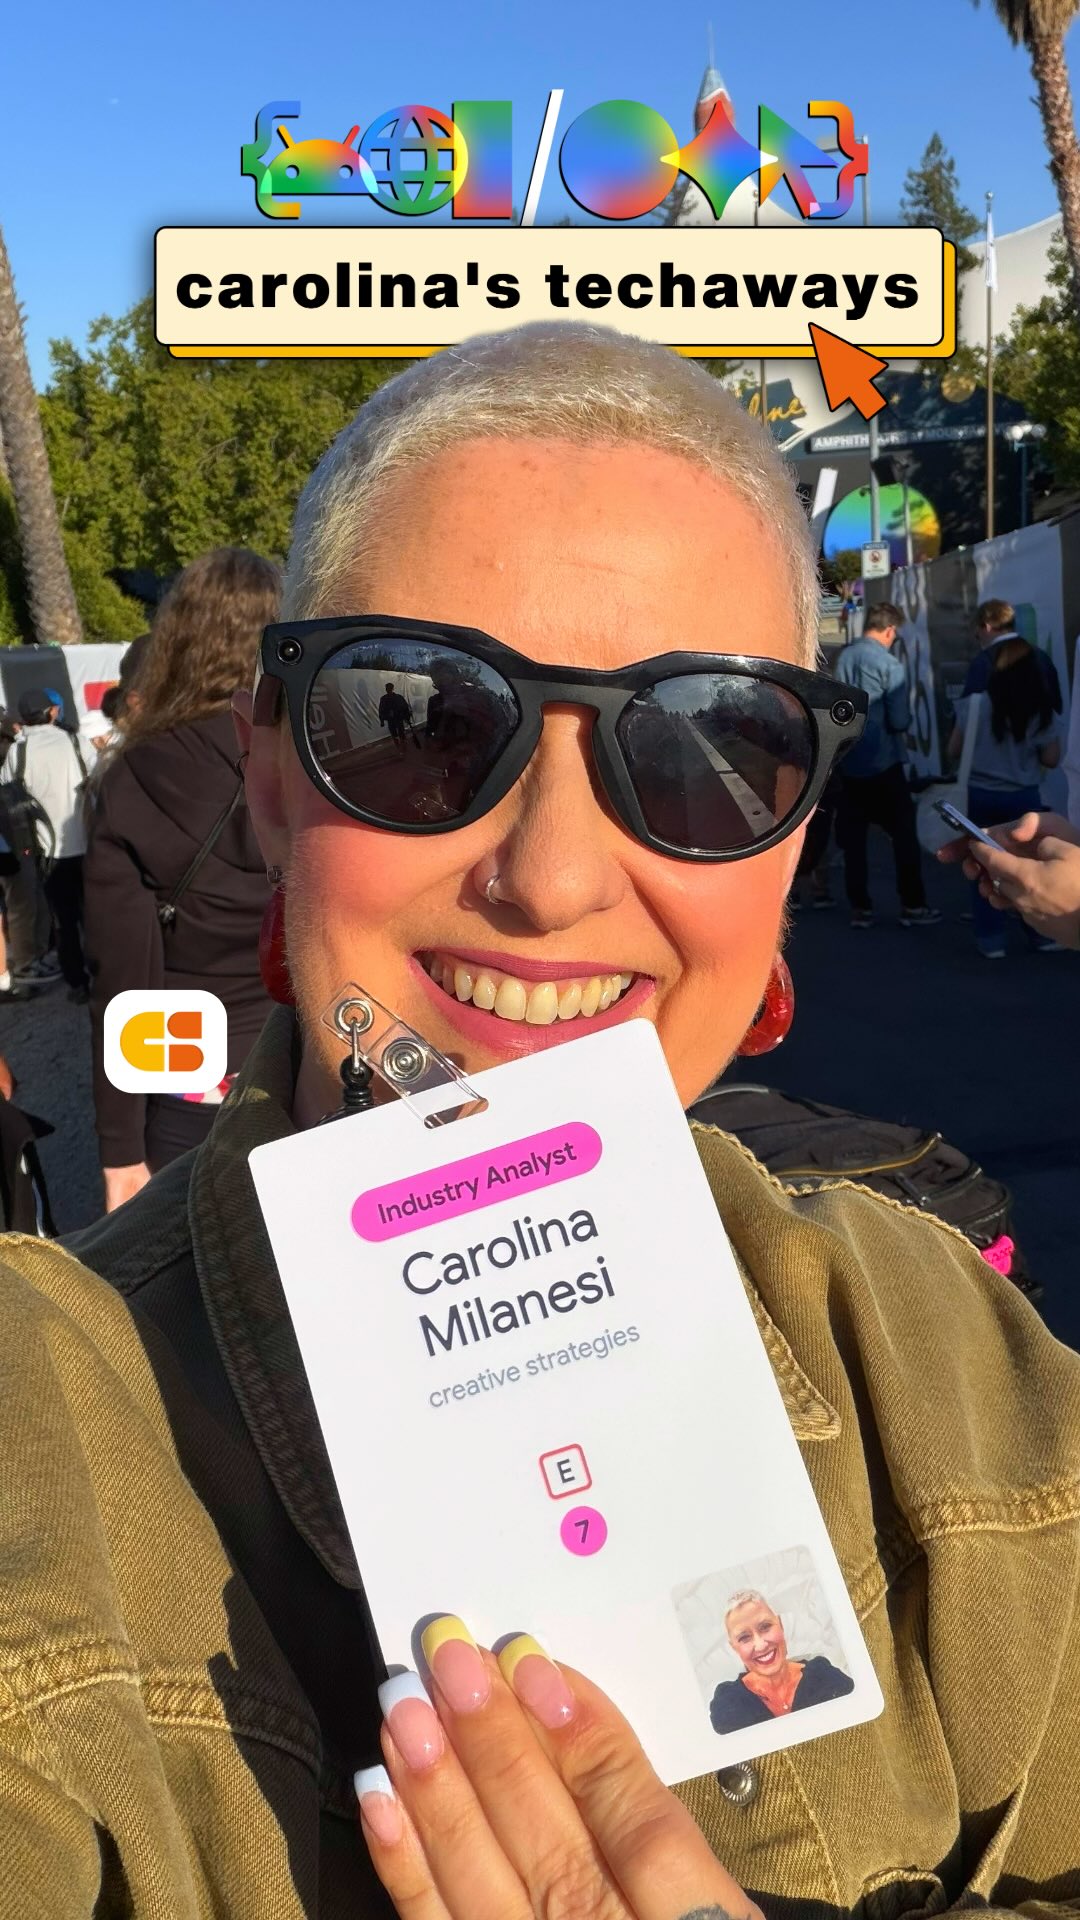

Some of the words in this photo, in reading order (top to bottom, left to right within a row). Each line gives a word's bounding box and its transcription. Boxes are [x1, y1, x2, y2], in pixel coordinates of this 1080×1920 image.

[813, 431, 906, 448] AMPHITHATRE
[377, 1177, 479, 1224] Industry
[487, 1142, 577, 1189] Analyst
[402, 1209, 599, 1295] Carolina
[419, 1255, 615, 1357] Milanesi
[429, 1365, 521, 1408] creative
[525, 1325, 640, 1376] strategies
[556, 1459, 576, 1485] E
[574, 1519, 591, 1544] 7
